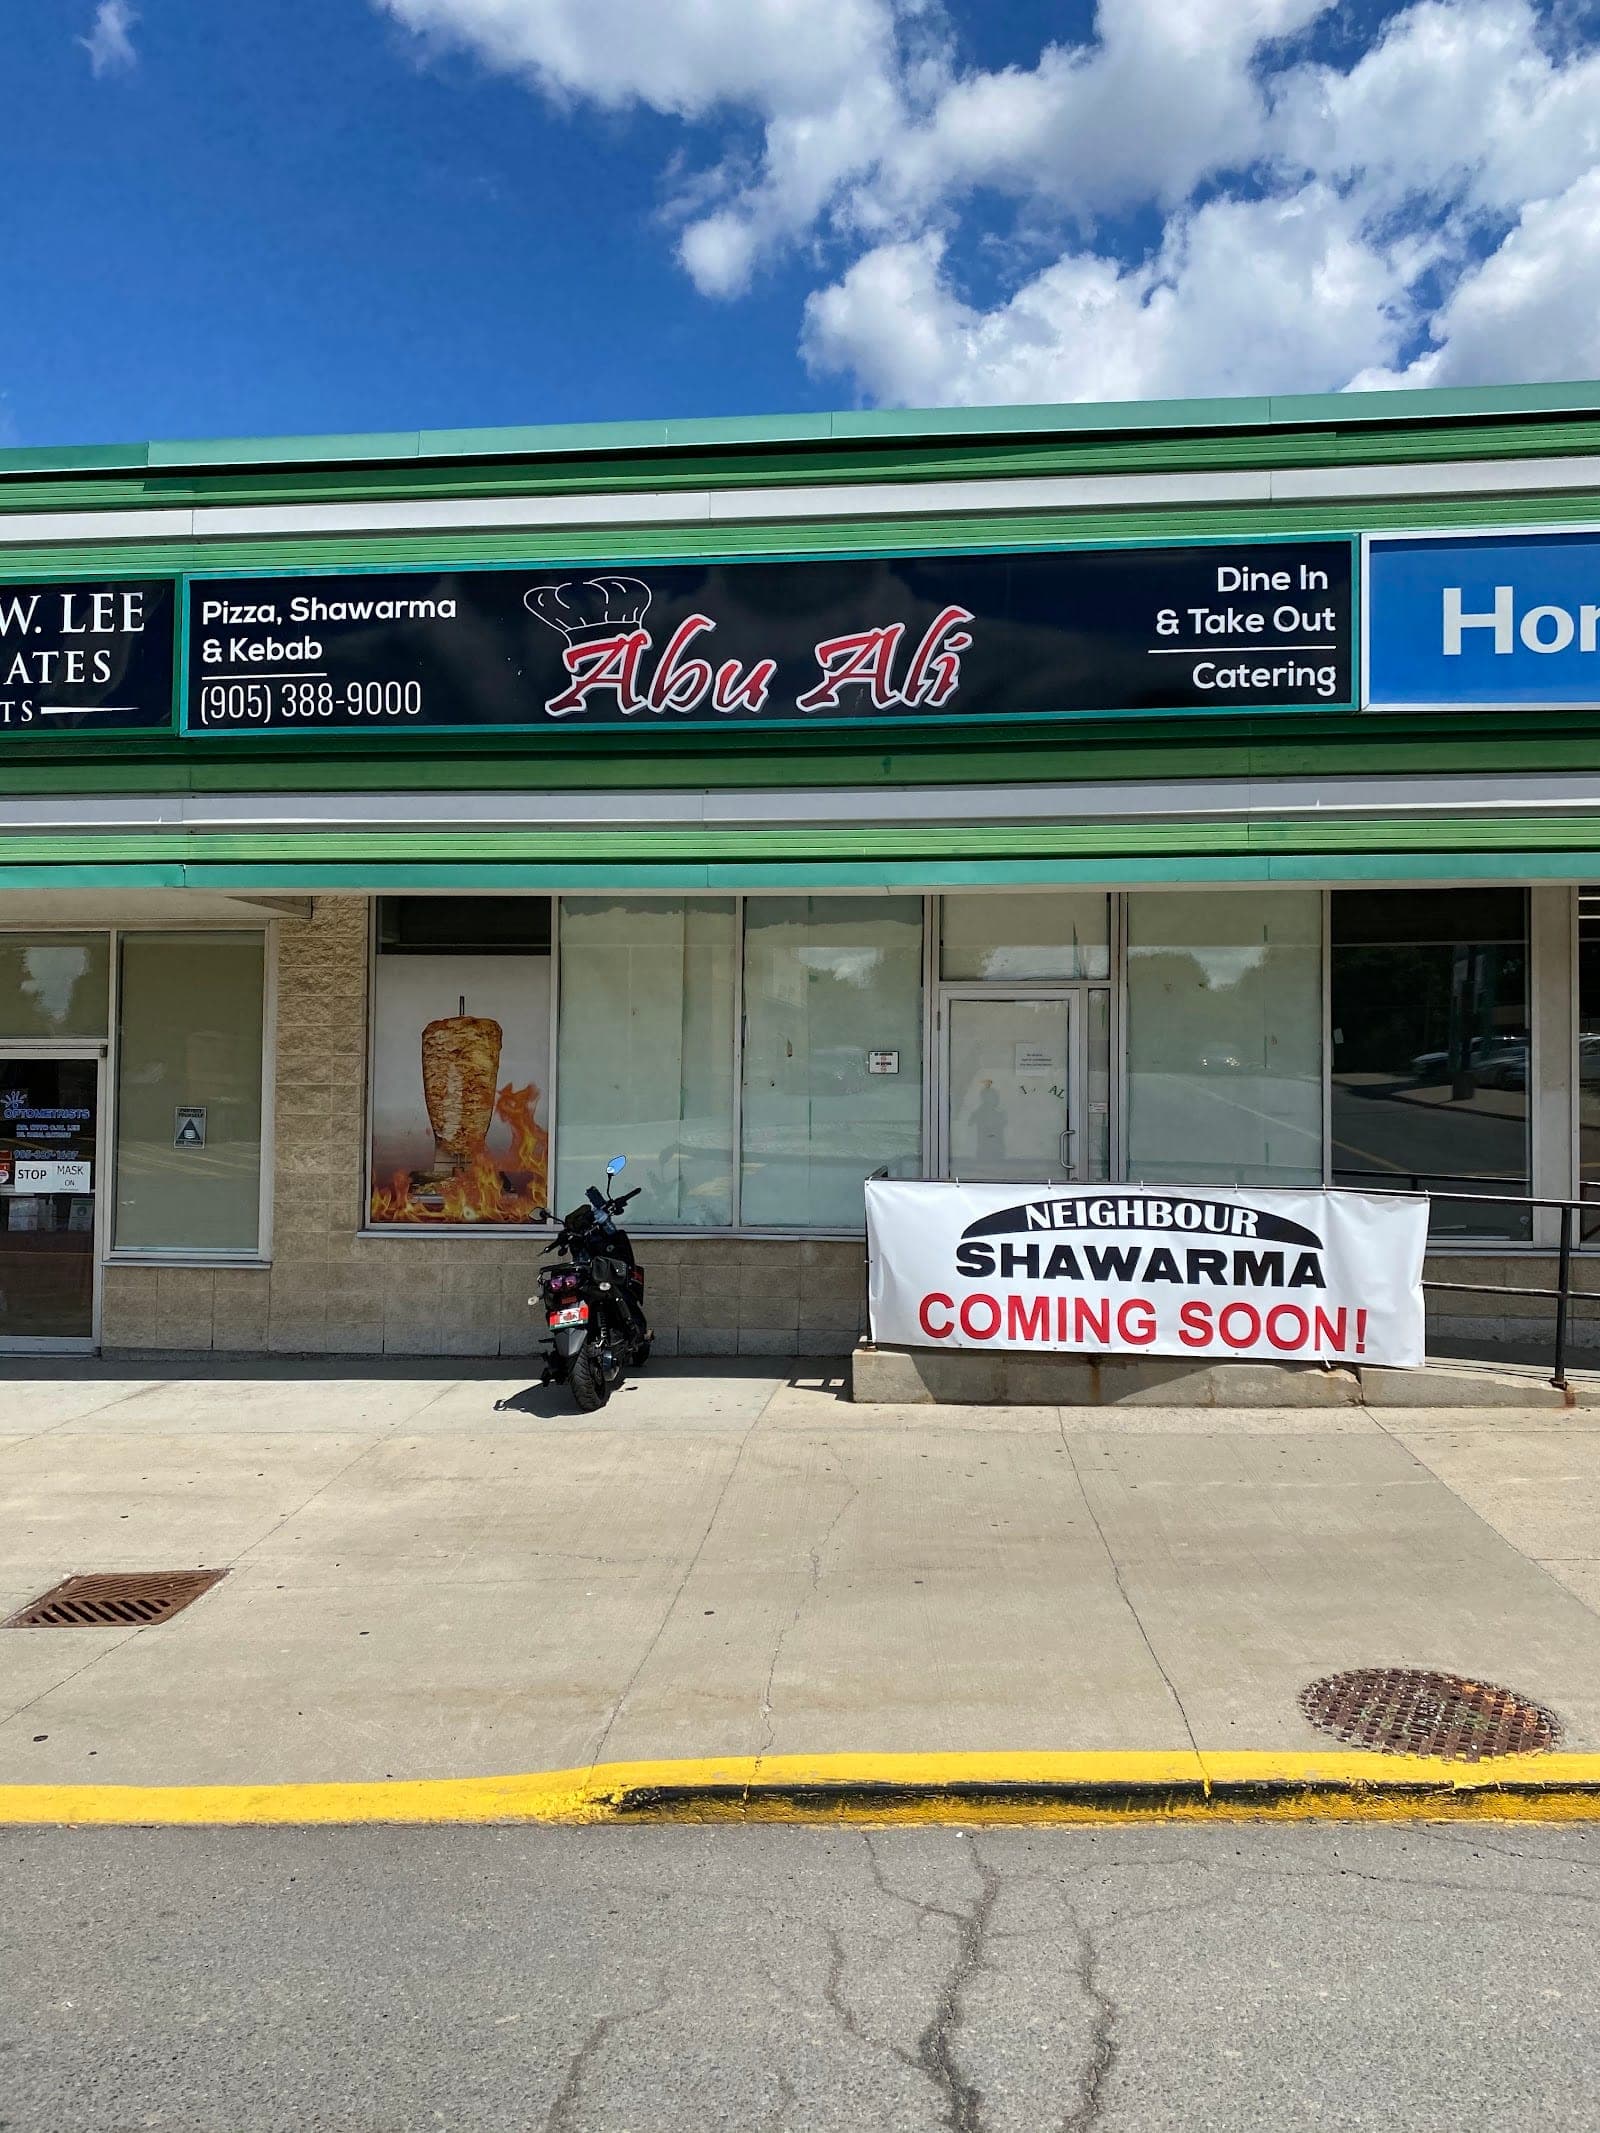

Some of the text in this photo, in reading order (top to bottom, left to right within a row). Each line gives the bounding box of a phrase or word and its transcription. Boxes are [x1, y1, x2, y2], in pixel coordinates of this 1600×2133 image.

[1217, 565, 1329, 593] Dine In
[60, 592, 145, 633] LEE
[202, 596, 457, 626] Pizza, Shawarma
[1156, 606, 1336, 635] & Take Out
[202, 635, 323, 664] & Kebab
[544, 605, 976, 718] Abu Ali
[3, 650, 111, 685] ATES
[1192, 660, 1337, 697] Catering
[200, 680, 422, 725] (905) 388-9000
[17, 1169, 47, 1180] STOP
[57, 1165, 84, 1175] MASK
[64, 1179, 75, 1187] ON
[1026, 1200, 1259, 1237] NEIGHBOUR
[955, 1241, 1326, 1289] SHAWARMA
[919, 1292, 1368, 1354] COMING SOON!
